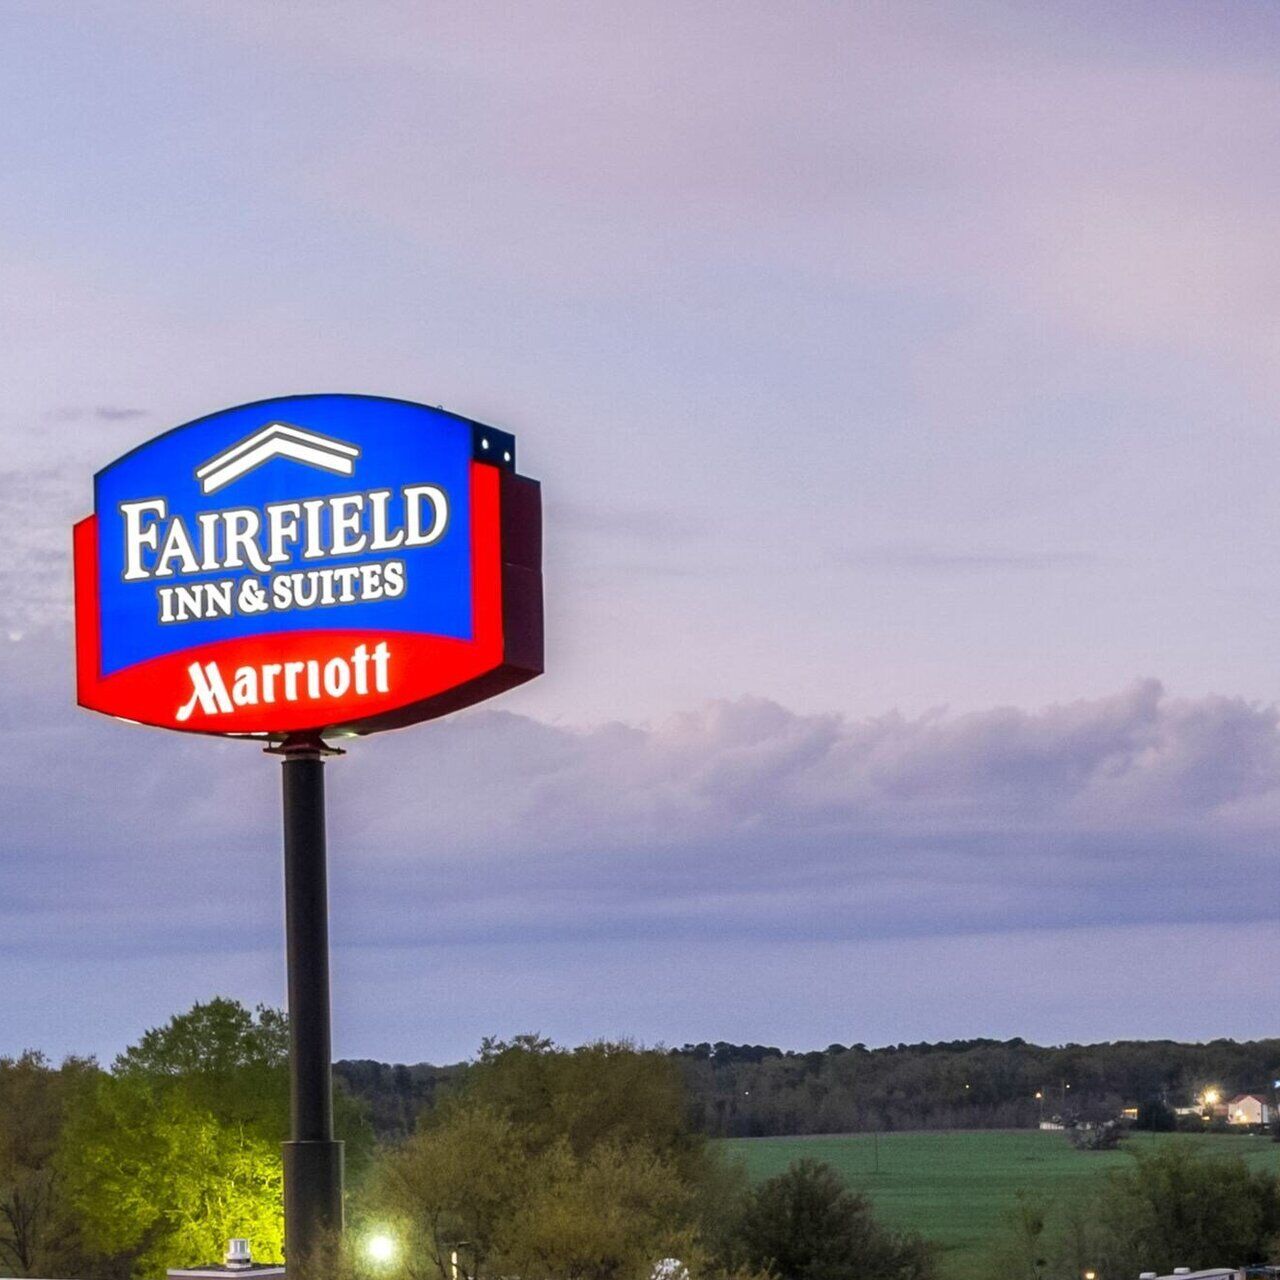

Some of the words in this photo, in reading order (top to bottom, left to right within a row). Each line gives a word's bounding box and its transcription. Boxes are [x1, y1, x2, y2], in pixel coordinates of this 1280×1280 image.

[119, 484, 449, 581] FAIRFIELD
[158, 580, 234, 623] INN
[237, 577, 270, 614] &
[272, 560, 405, 610] SUITES
[174, 640, 392, 722] Marriott
